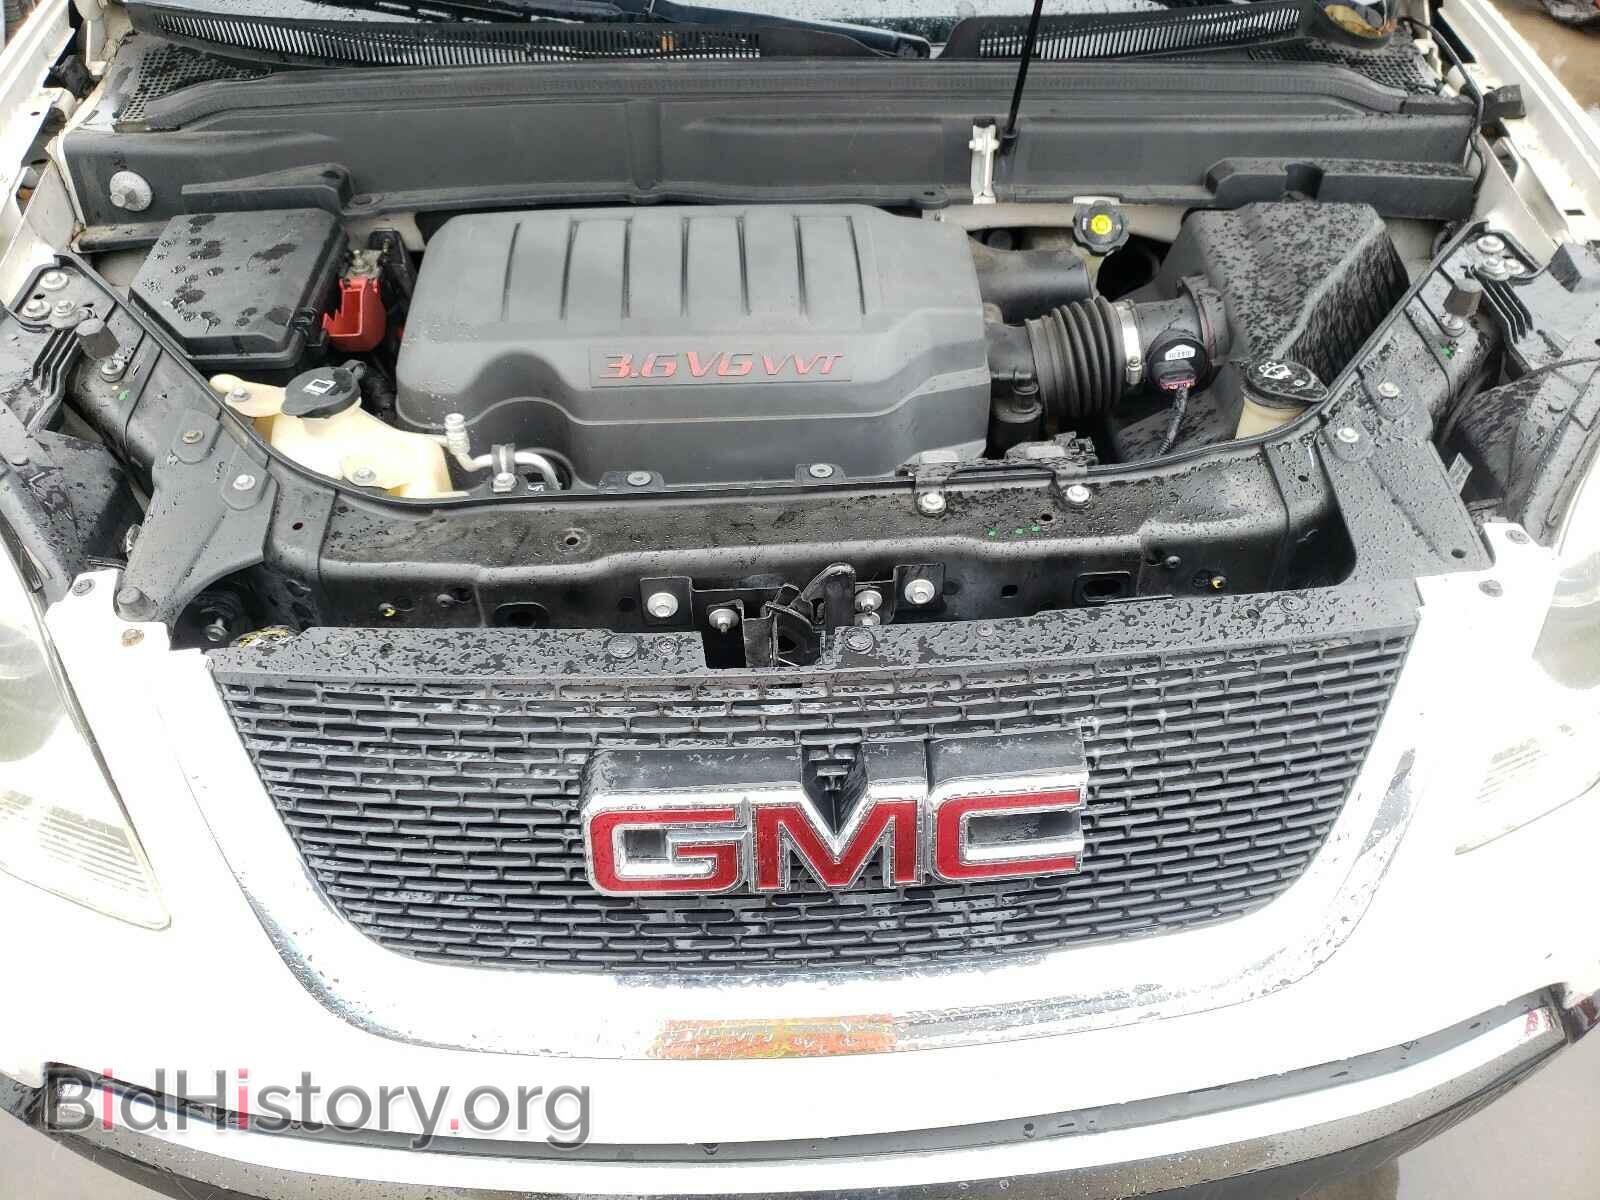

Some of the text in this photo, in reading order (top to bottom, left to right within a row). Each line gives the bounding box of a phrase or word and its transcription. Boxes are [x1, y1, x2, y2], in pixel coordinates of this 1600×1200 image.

[600, 351, 844, 378] 3.6 V6 VVT
[584, 776, 1088, 897] GMC
